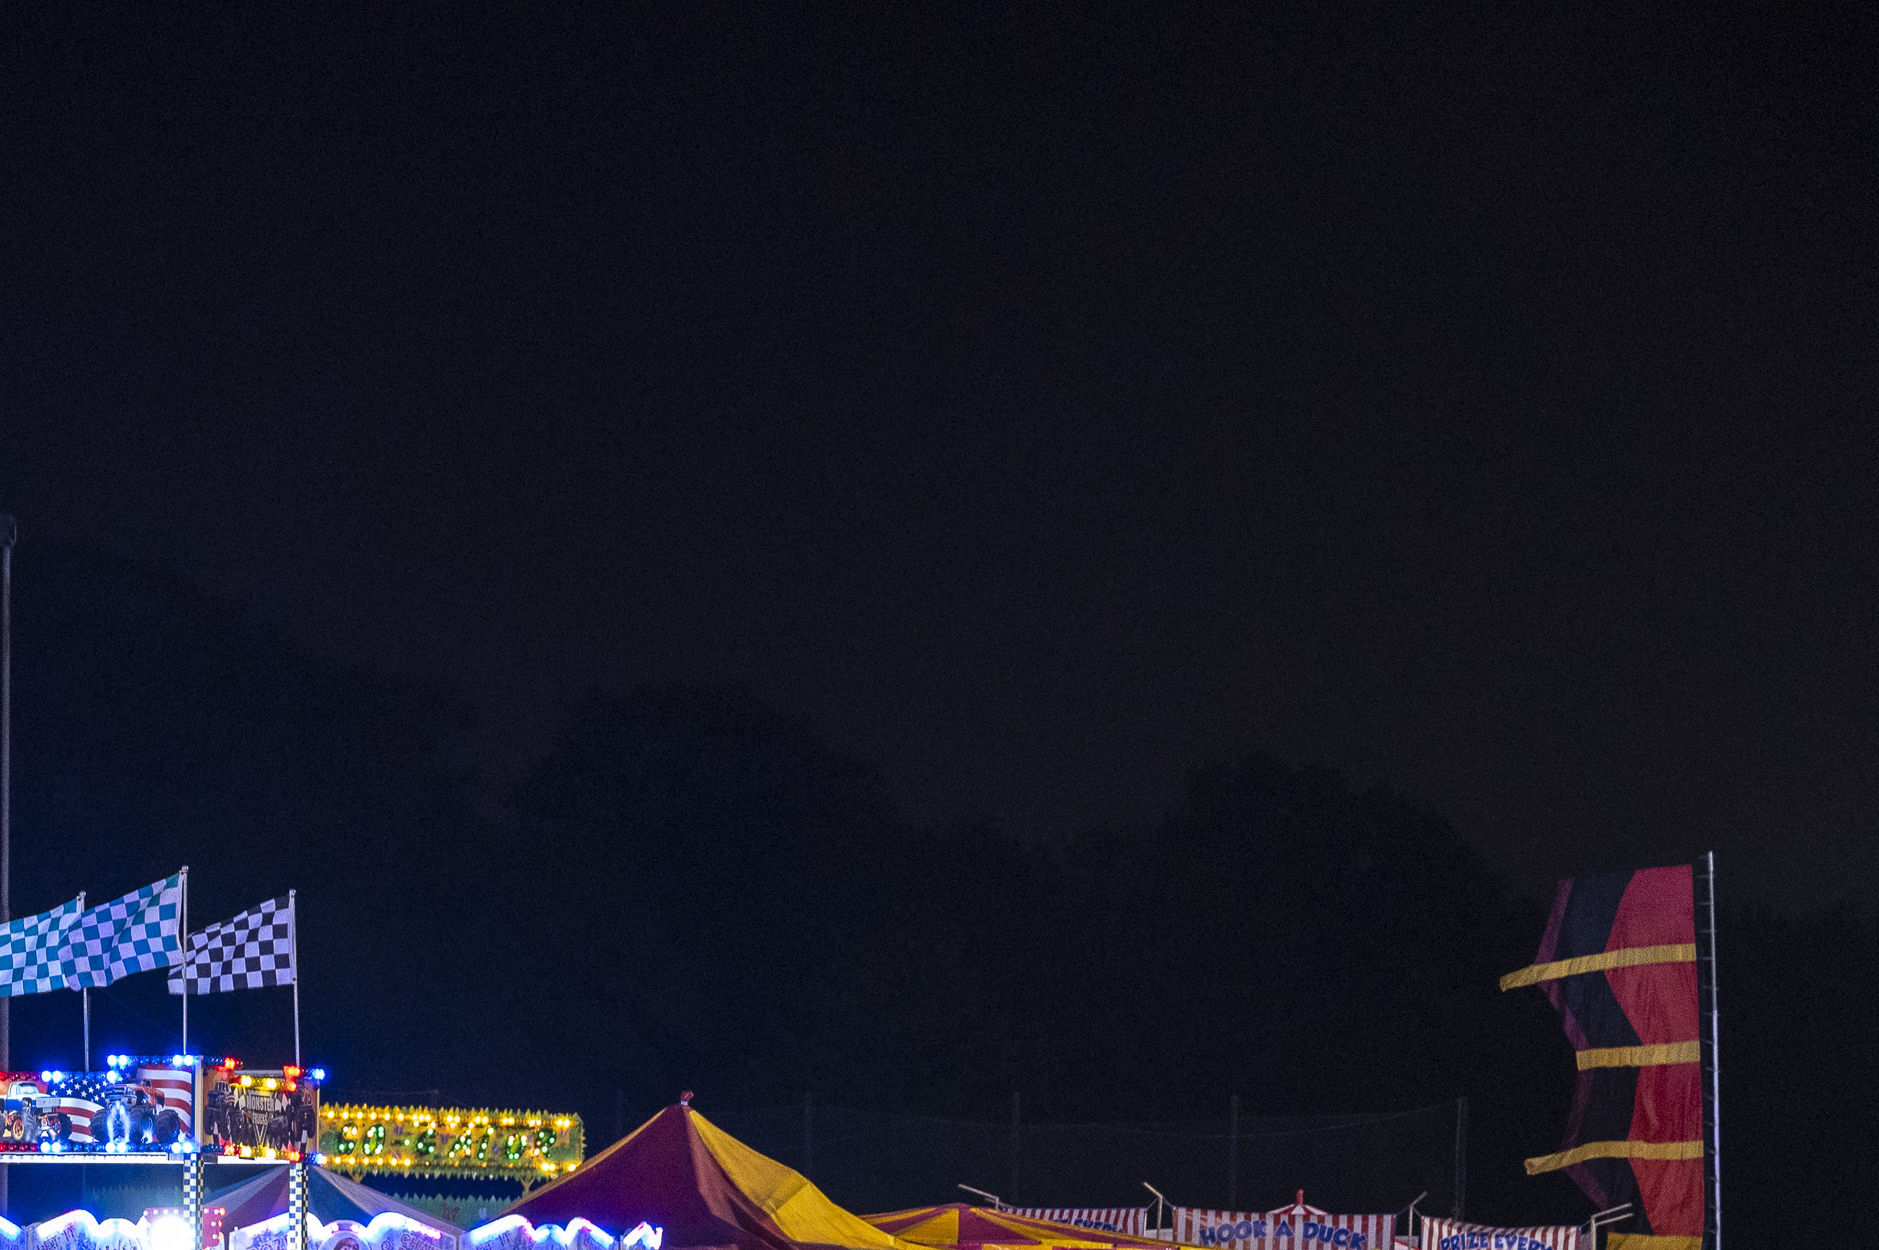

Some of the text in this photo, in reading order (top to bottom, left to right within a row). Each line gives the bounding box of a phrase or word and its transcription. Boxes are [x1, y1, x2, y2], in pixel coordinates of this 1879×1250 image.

[1199, 1219, 1367, 1250] HOOK A DUCK
